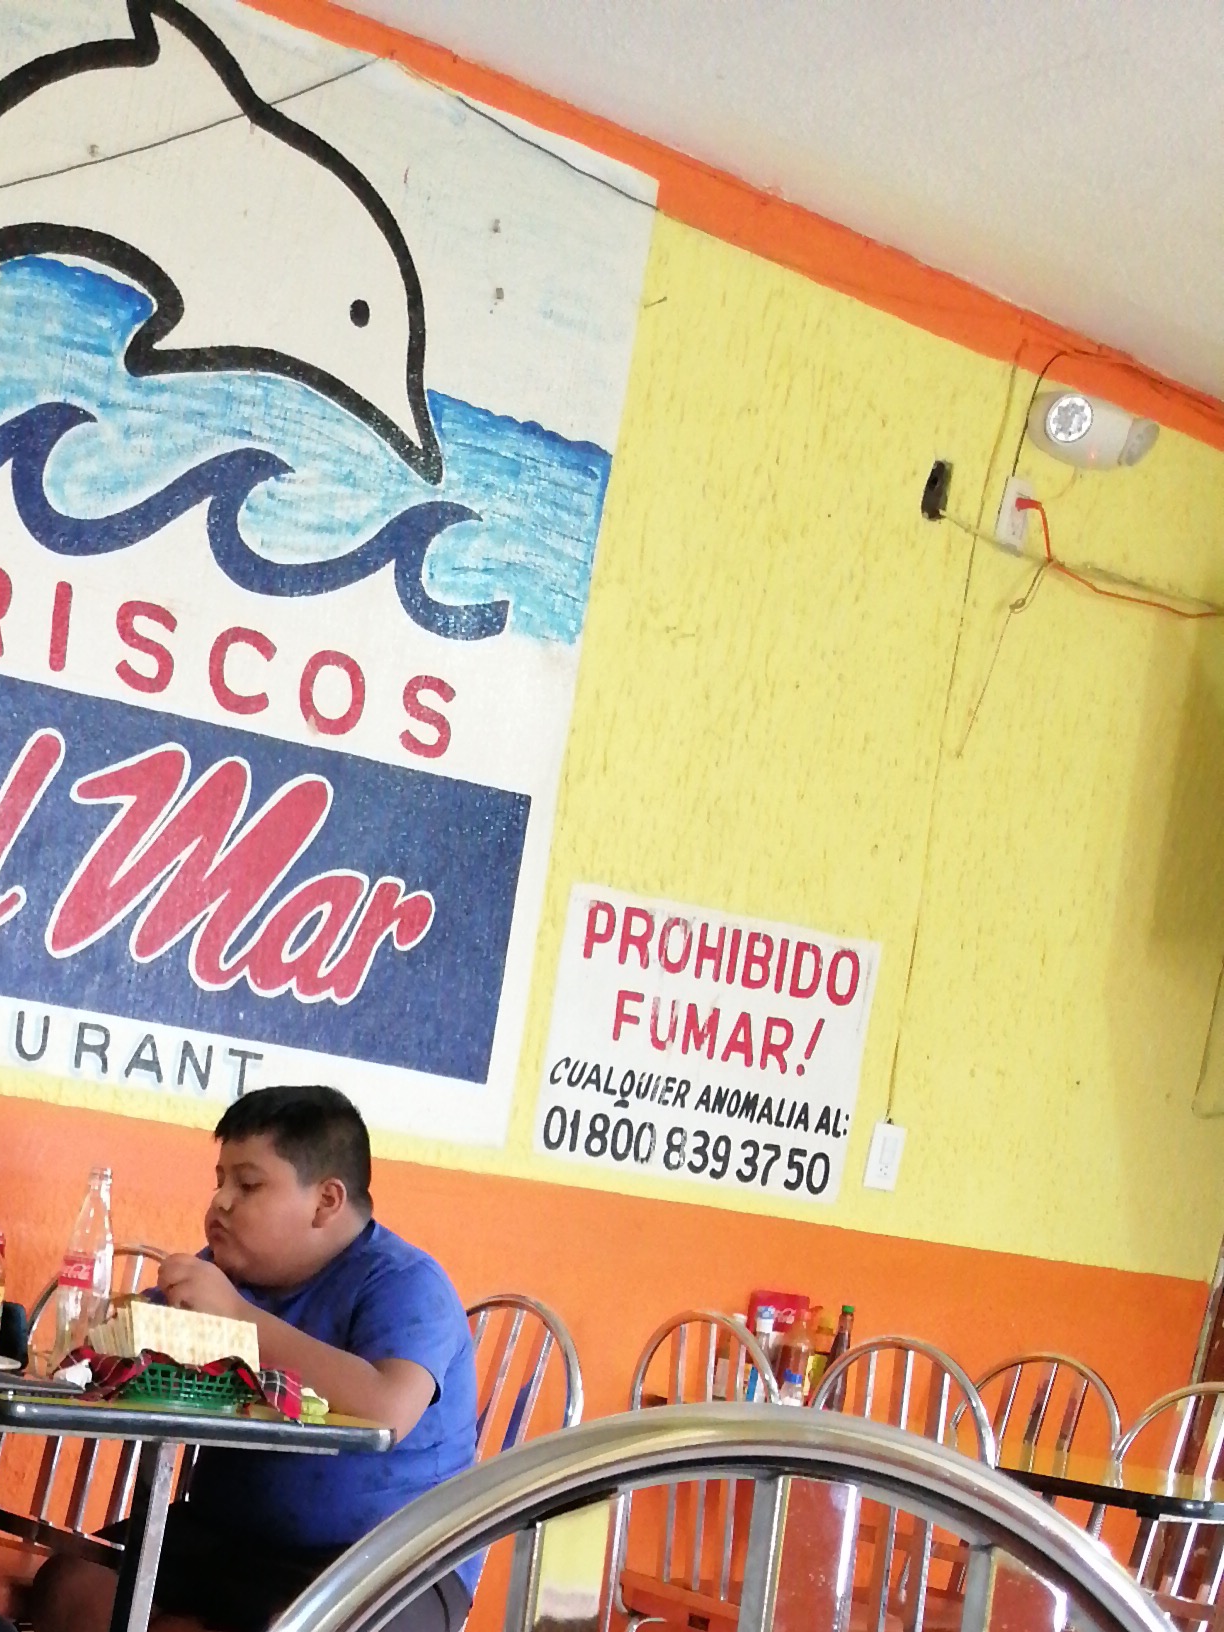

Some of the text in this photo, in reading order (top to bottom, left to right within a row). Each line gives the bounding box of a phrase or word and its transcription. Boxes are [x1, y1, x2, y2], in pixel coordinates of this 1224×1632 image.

[44, 741, 434, 1005] Mar
[582, 900, 861, 1006] PROHIBIDO
[612, 989, 826, 1077] FUMAR!
[549, 1056, 850, 1139] CUALQUIER ANOMALIA AL:
